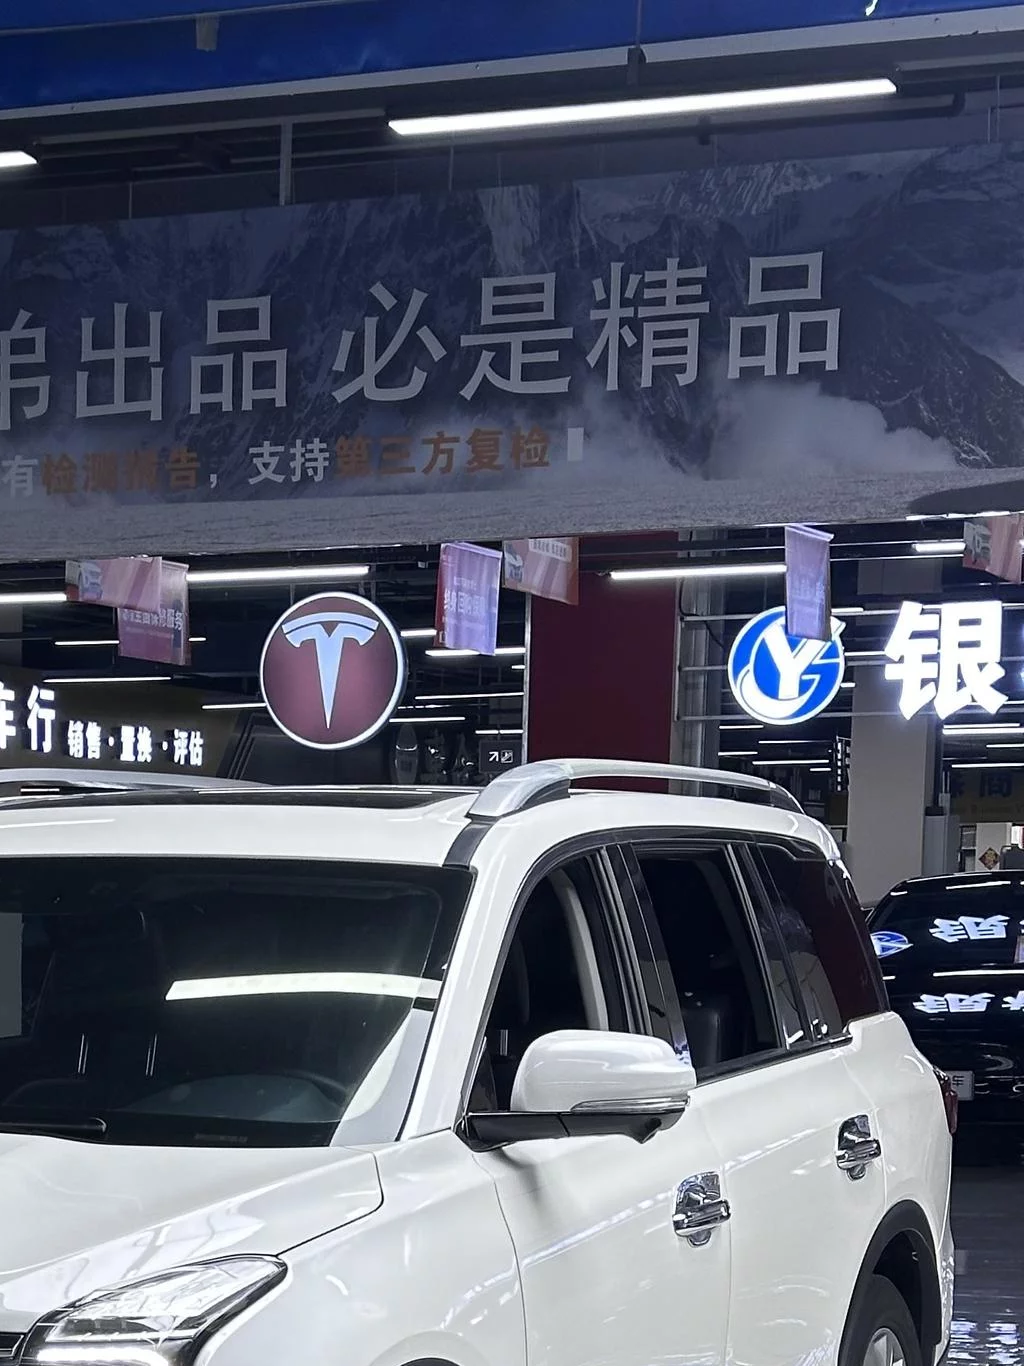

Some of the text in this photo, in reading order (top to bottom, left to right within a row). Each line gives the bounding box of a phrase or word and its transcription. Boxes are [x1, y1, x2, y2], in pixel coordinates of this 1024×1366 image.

[330, 249, 844, 405] 必是精品
[884, 599, 1010, 720] 银
